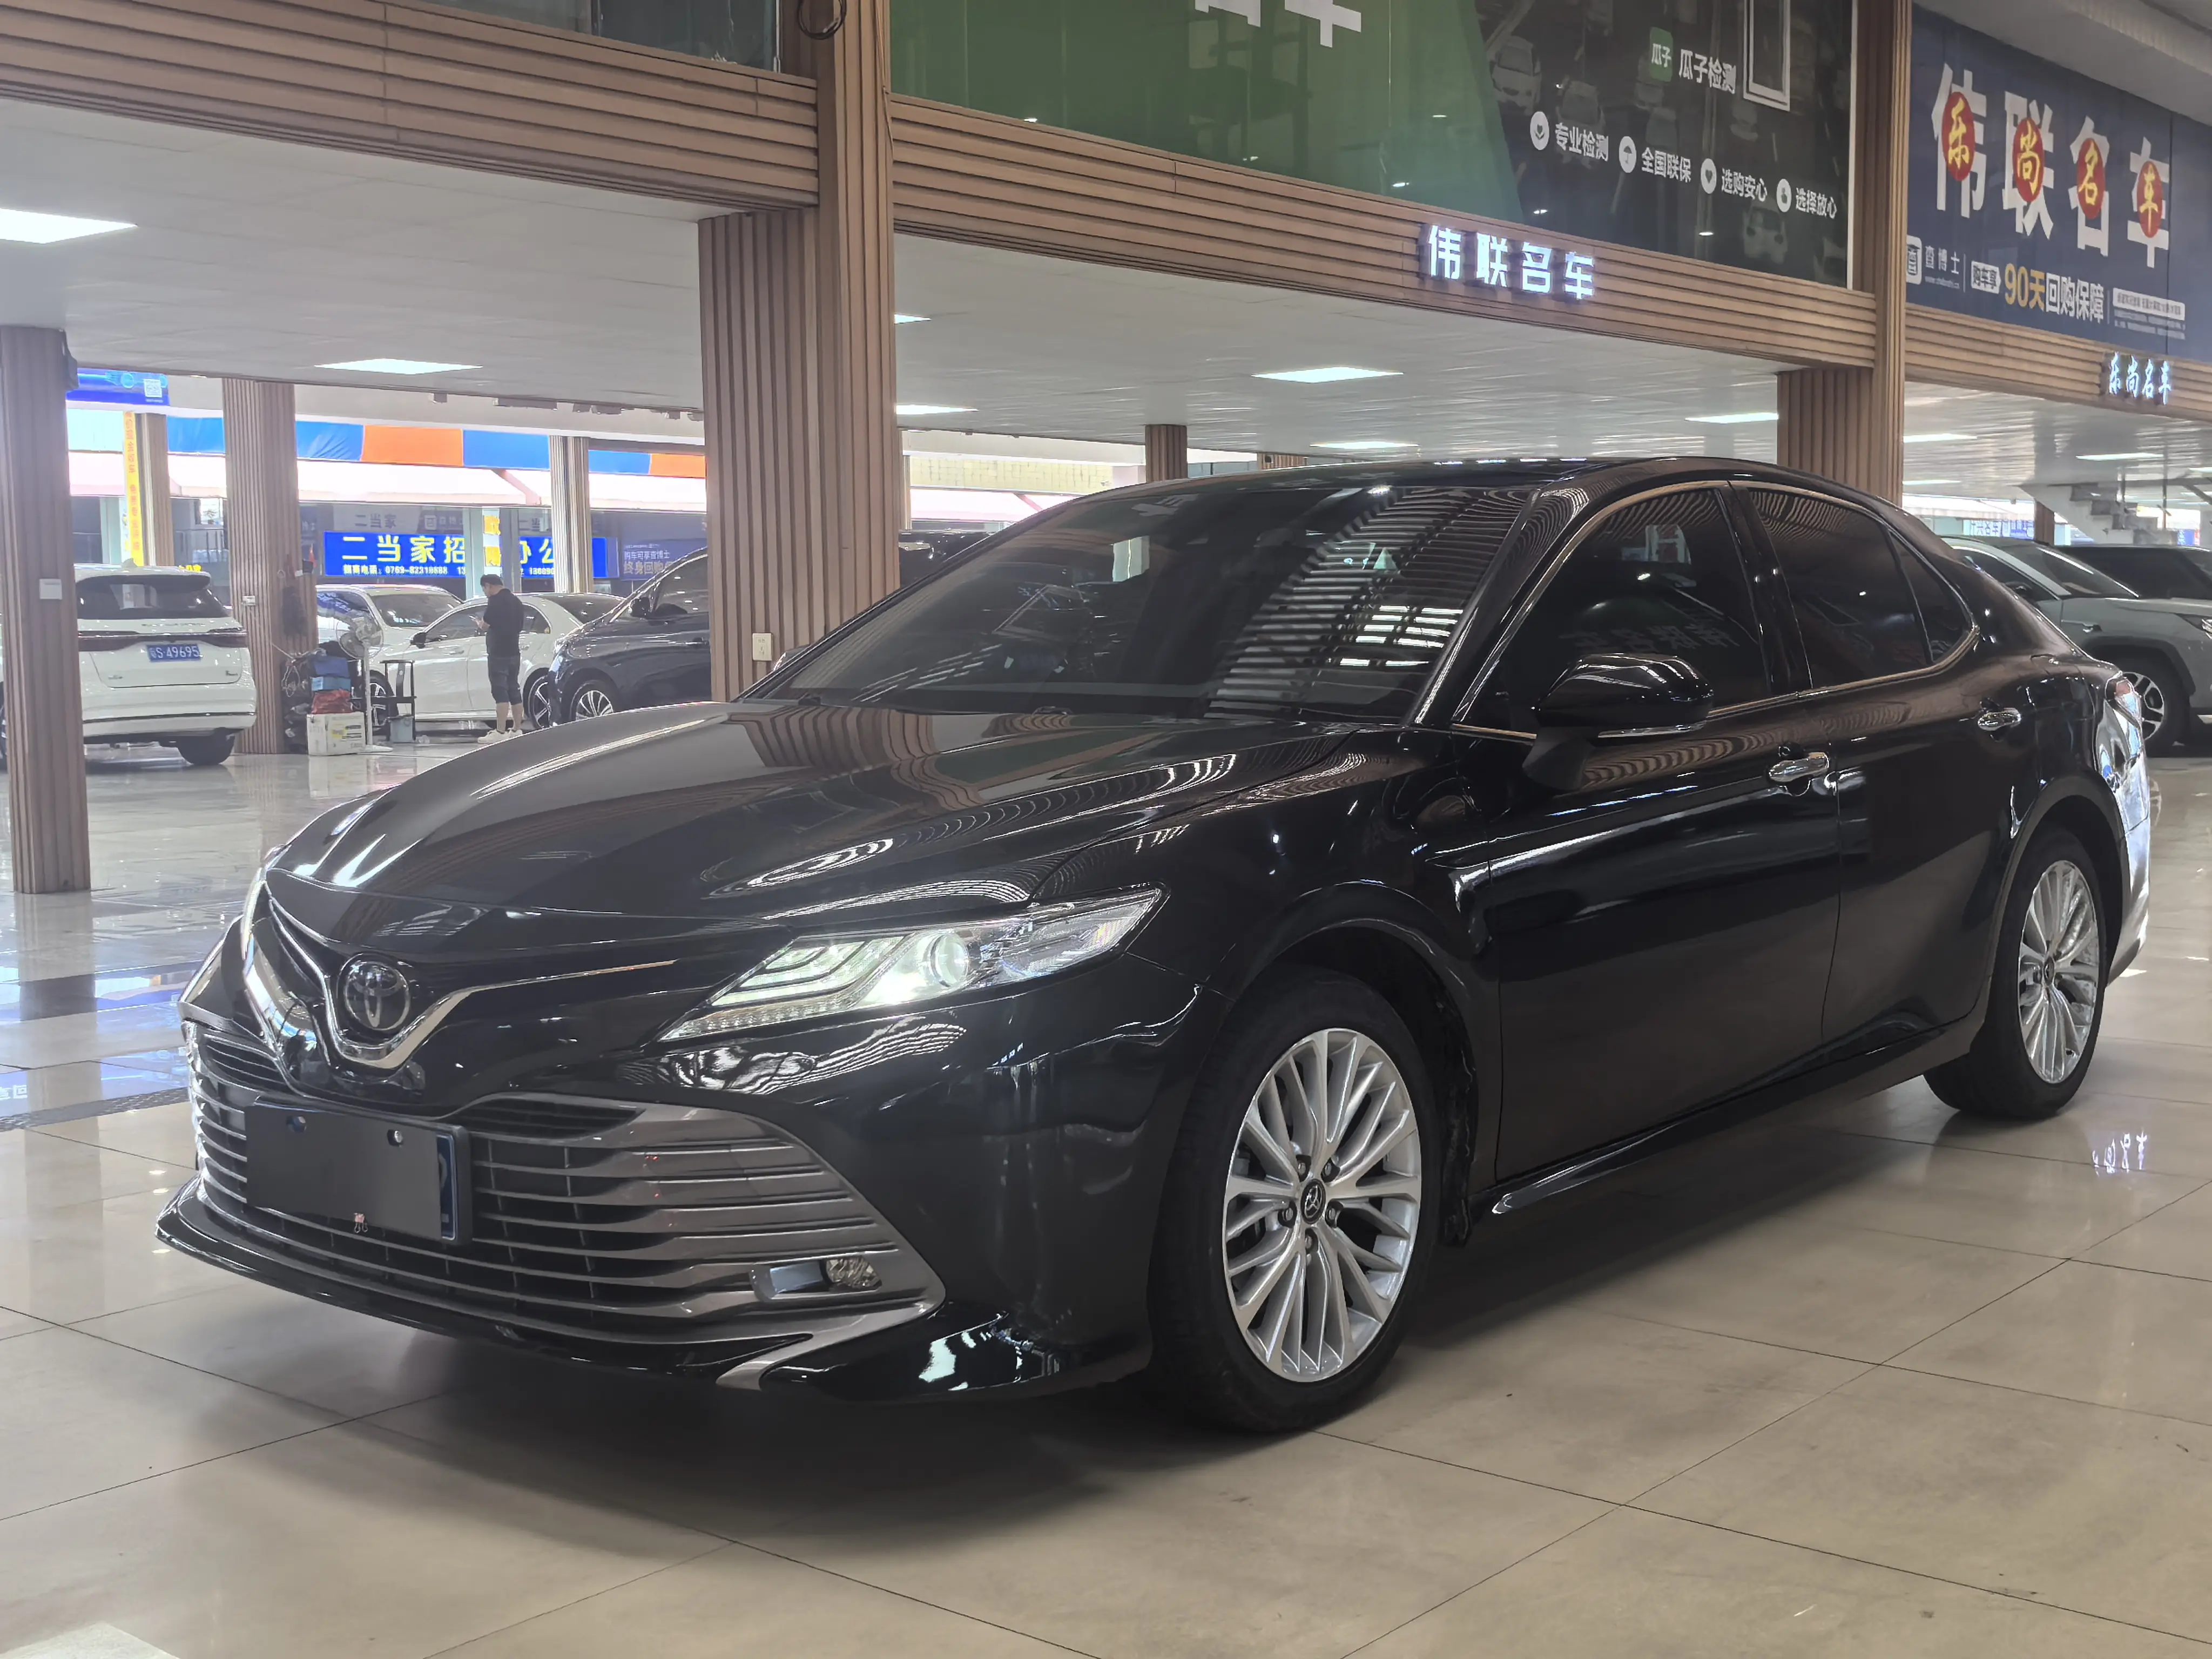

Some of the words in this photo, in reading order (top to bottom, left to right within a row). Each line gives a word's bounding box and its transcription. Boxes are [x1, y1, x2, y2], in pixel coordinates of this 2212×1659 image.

[1651, 43, 1671, 68] 瓜子
[1678, 49, 1736, 94] 瓜子检测
[1555, 122, 1609, 161] 专业检测
[1641, 146, 1691, 183] 全国联保
[1721, 167, 1768, 202] 选购安心
[1796, 187, 1837, 219] 选择放心
[1428, 224, 1594, 300] 伟联名车
[2005, 262, 2103, 324] 90天回购保障
